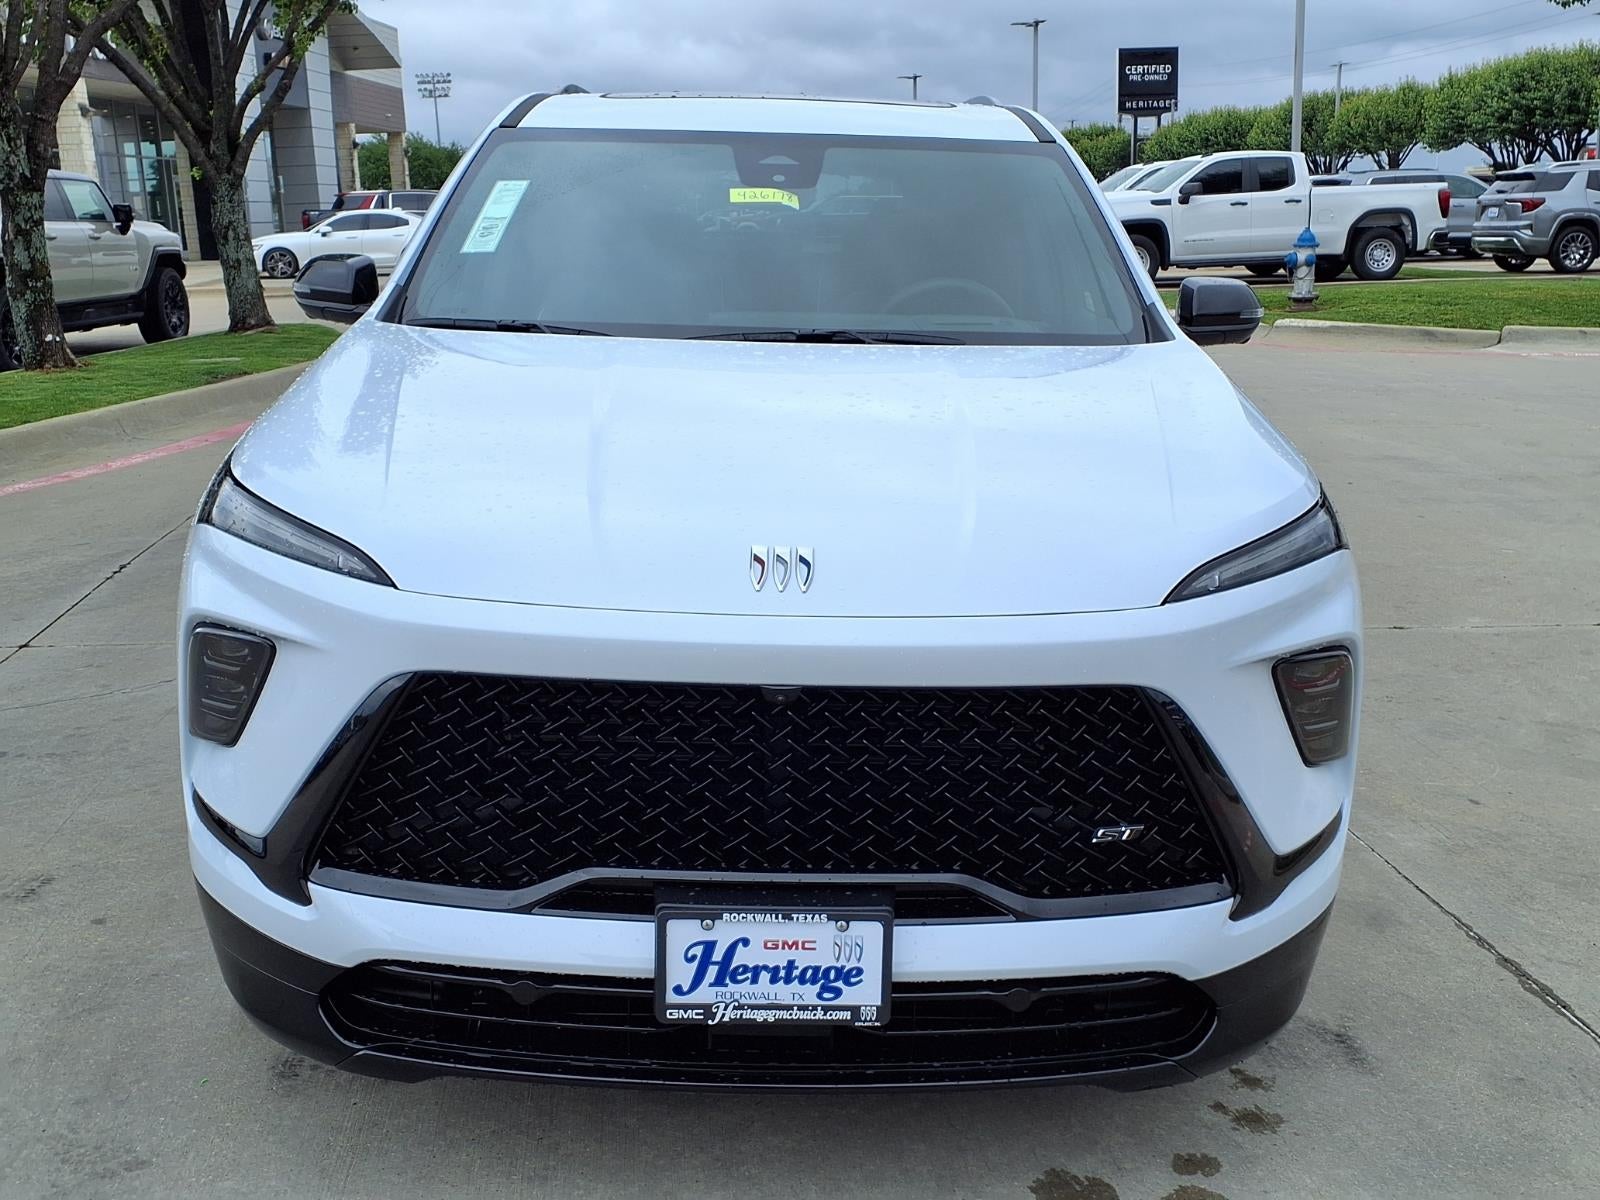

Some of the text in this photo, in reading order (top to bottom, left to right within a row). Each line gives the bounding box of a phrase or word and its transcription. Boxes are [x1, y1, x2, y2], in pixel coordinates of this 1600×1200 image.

[1125, 64, 1172, 74] CERTIFIED
[1125, 100, 1171, 109] HERITAGE
[737, 190, 793, 202] 426178
[1092, 824, 1144, 843] ST
[722, 913, 828, 924] ROCKWALL, TEXAS
[763, 939, 817, 951] GMC
[672, 936, 865, 1002] Heritage
[715, 991, 805, 1002] ROCKWALL, TX
[666, 1009, 704, 1019] GMC
[708, 1001, 852, 1025] Heritagegmcbuick.com
